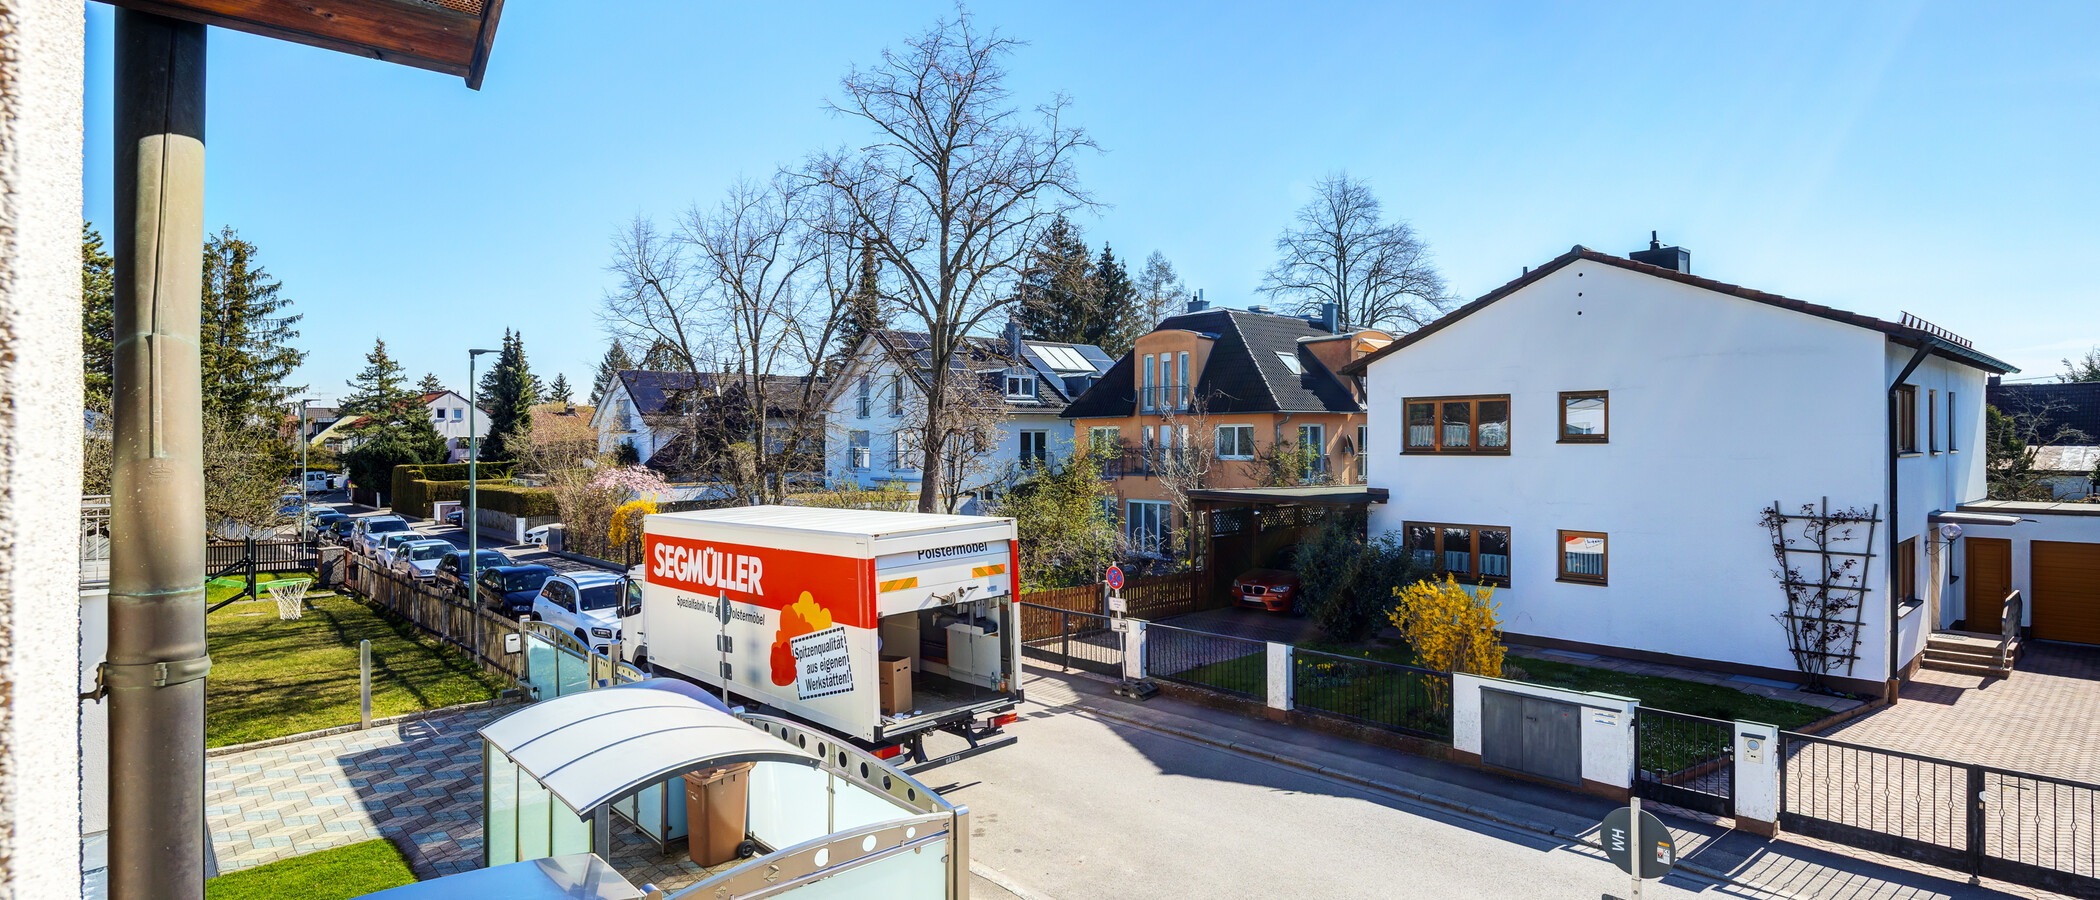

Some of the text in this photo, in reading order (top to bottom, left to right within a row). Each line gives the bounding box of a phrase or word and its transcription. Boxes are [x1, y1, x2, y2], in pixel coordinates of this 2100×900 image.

[653, 542, 764, 596] SEGMÜLLER
[677, 595, 706, 613] Spezialfabrik
[707, 602, 715, 614] für
[732, 608, 765, 625] olstermöbel
[795, 635, 844, 662] Spitzenqualität
[806, 655, 847, 674] aus eigenen
[805, 670, 850, 691] Werkstätten!
[1611, 828, 1625, 852] WH
